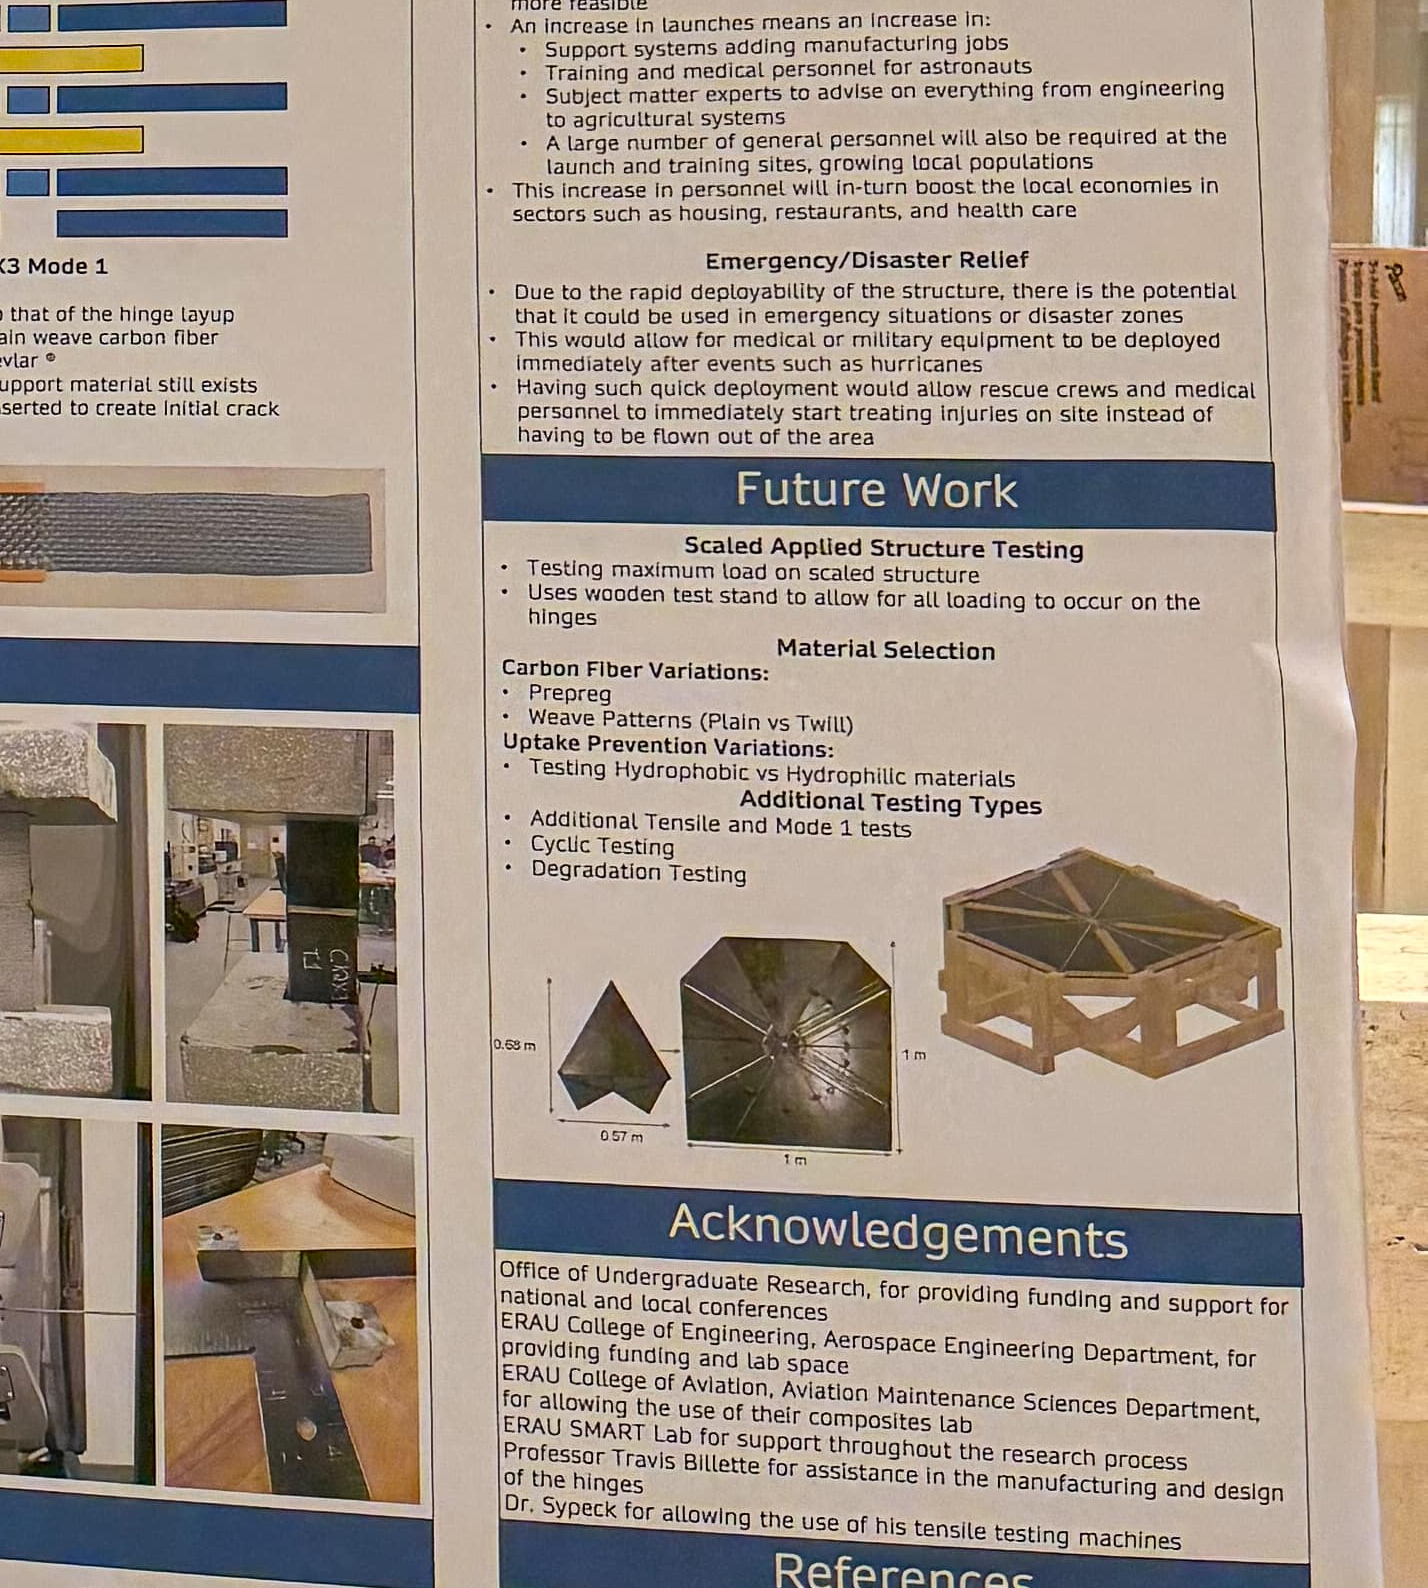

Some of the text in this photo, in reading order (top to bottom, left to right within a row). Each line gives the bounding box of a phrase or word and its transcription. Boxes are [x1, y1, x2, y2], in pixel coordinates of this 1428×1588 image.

[510, 10, 991, 35] An increase in launches means an increase in:
[28, 257, 88, 275] Mode
[95, 258, 109, 275] 1
[706, 250, 1030, 274] Emergency/Disaster Relief
[738, 470, 1019, 508] Future Work
[684, 536, 1084, 564] Scaled Applied Structure Testing
[777, 638, 995, 661] Material Selection
[739, 789, 1043, 819] Additional Testing Types
[669, 1202, 1129, 1261] Acknowledgements
[501, 1288, 828, 1322] national and local conferences
